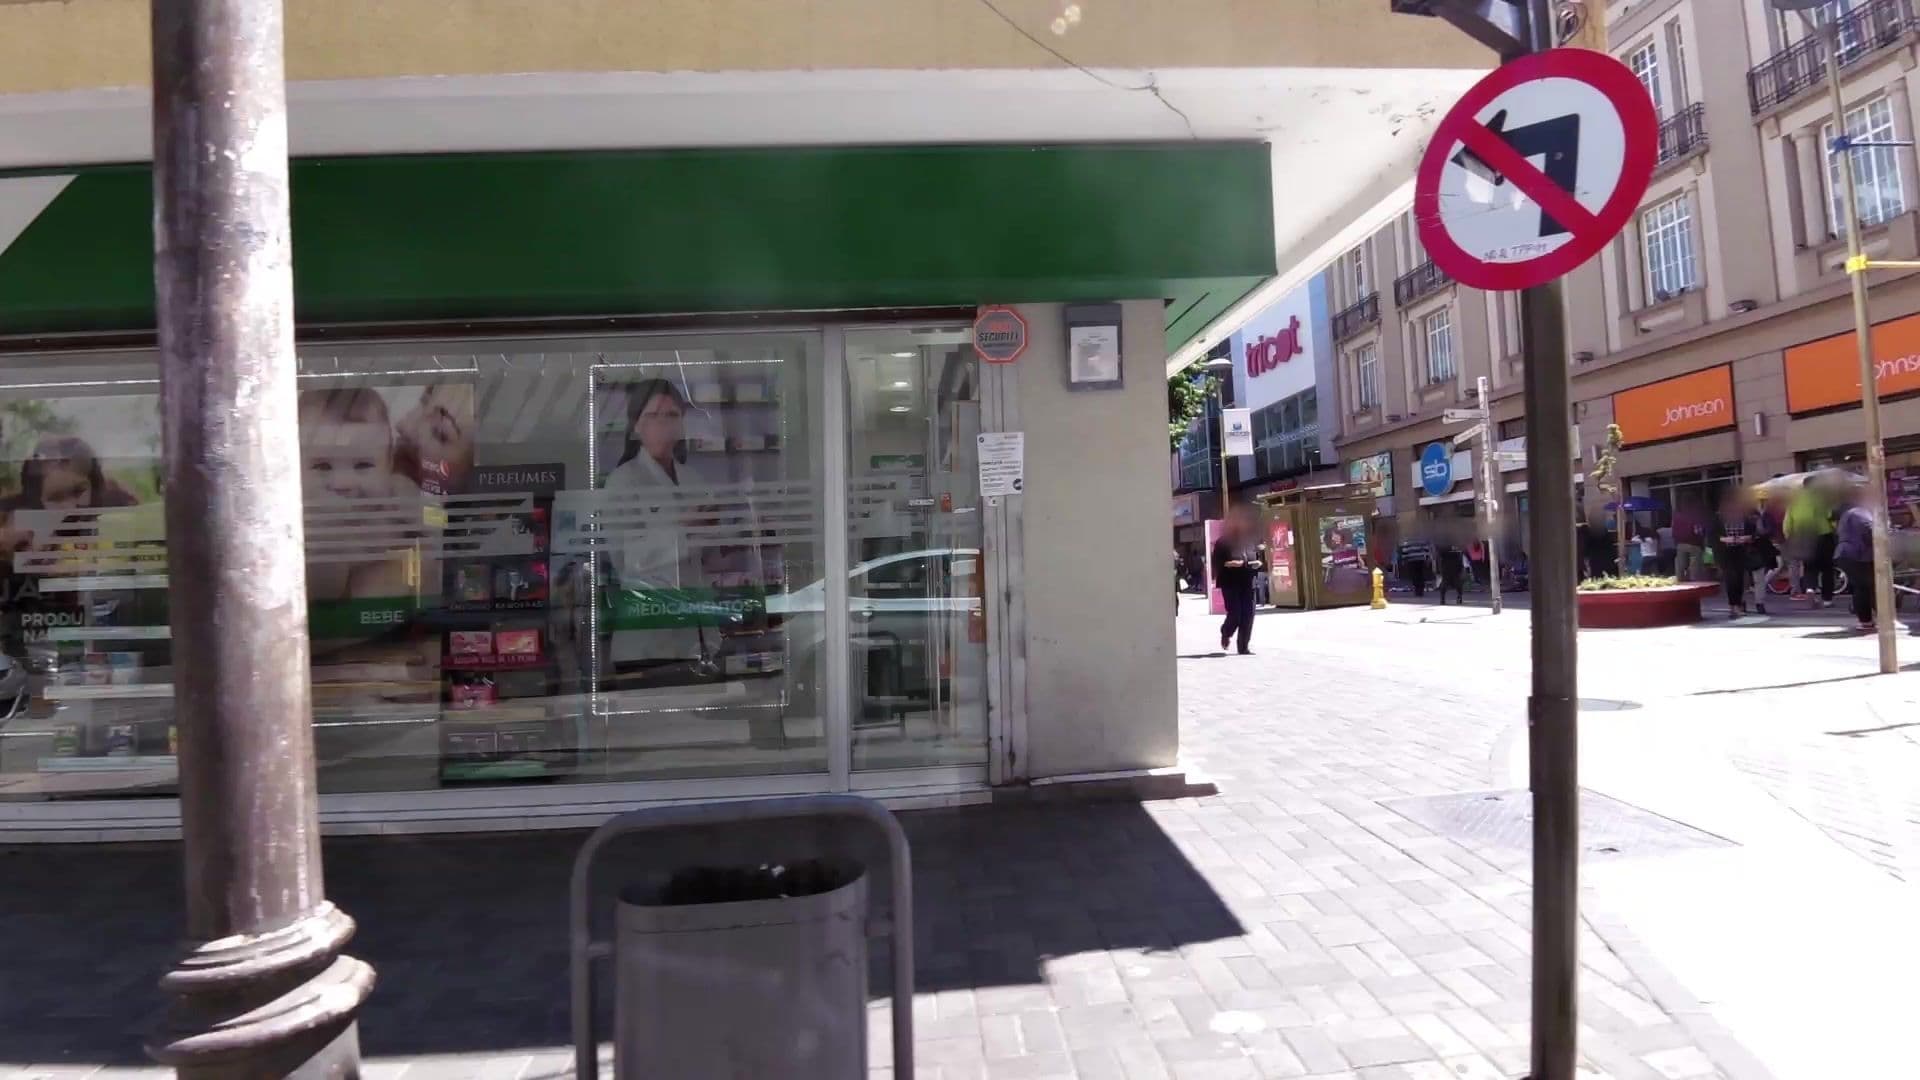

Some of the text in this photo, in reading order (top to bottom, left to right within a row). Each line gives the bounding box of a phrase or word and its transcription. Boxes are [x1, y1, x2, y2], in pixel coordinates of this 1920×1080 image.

[1246, 315, 1303, 378] tricot
[1661, 398, 1724, 427] Johnson
[478, 471, 557, 485] PERFUMES
[1423, 459, 1448, 479] sb
[360, 610, 405, 624] BEBE
[628, 600, 754, 617] MEDICAMENTOS
